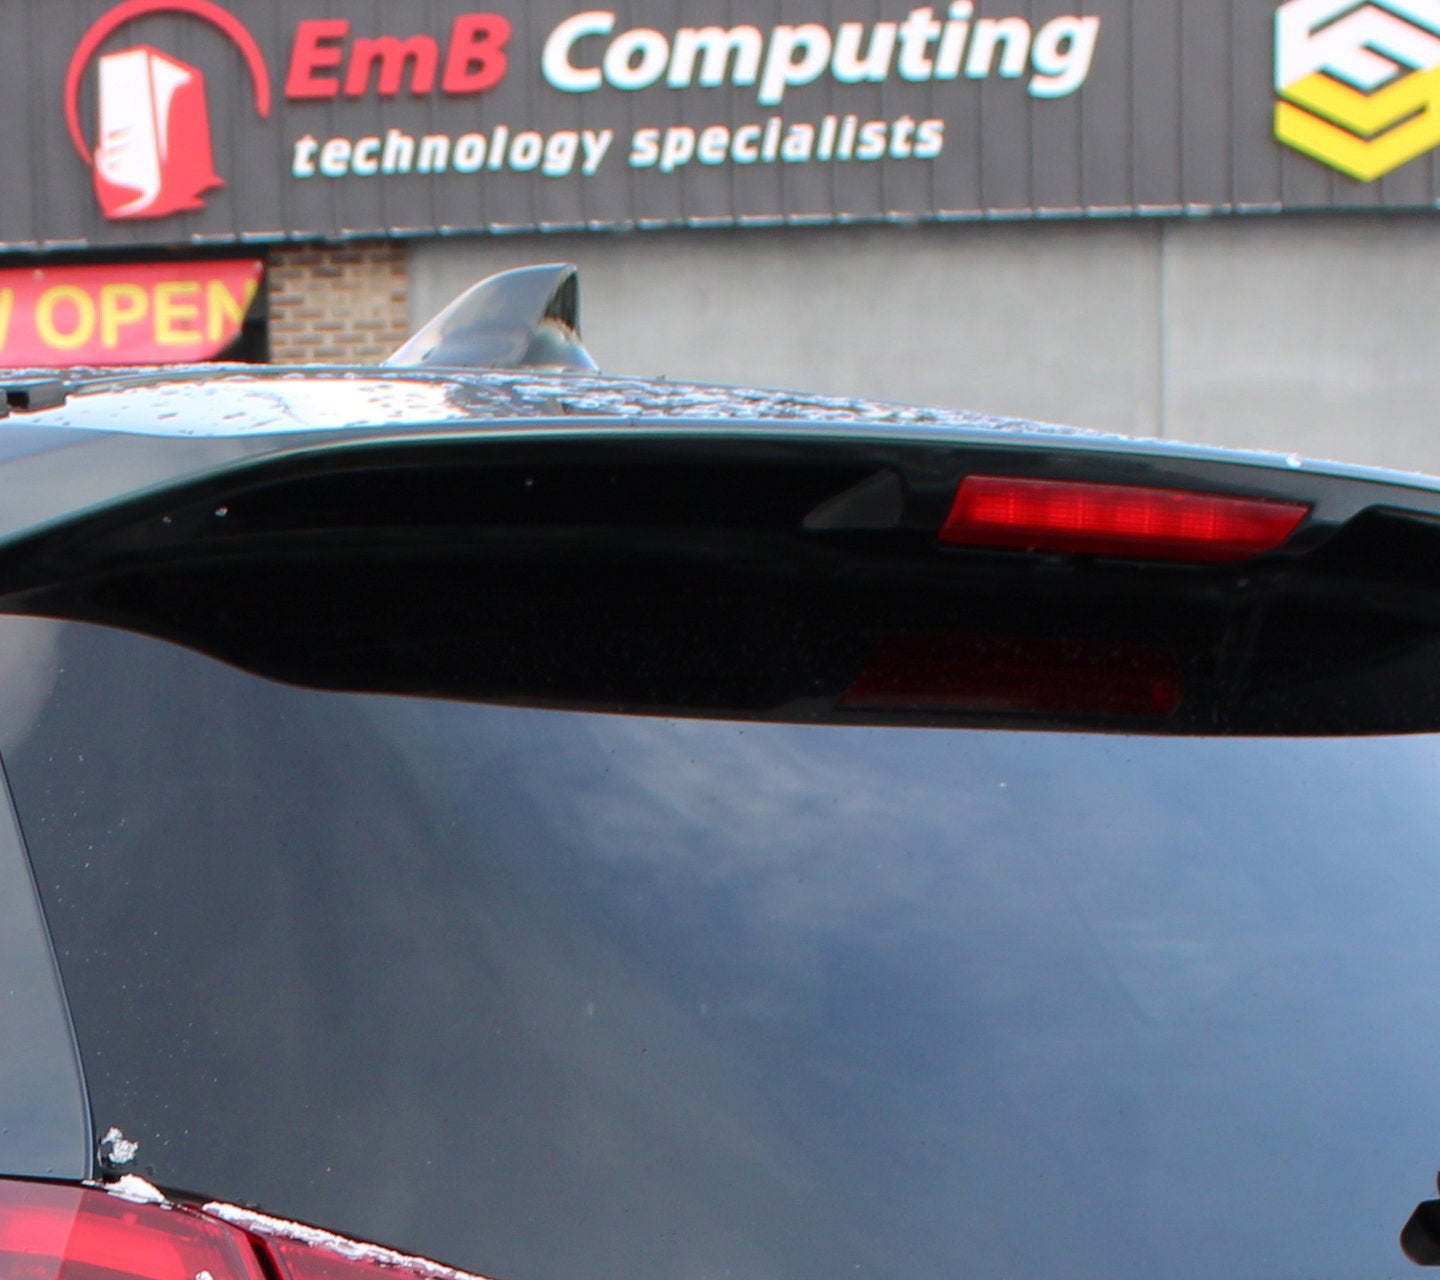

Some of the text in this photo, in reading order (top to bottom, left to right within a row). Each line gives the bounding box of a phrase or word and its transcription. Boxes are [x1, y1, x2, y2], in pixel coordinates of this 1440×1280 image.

[285, 2, 1100, 106] EmB Computing
[293, 115, 944, 177] technology specialists
[34, 279, 259, 349] OPEN
